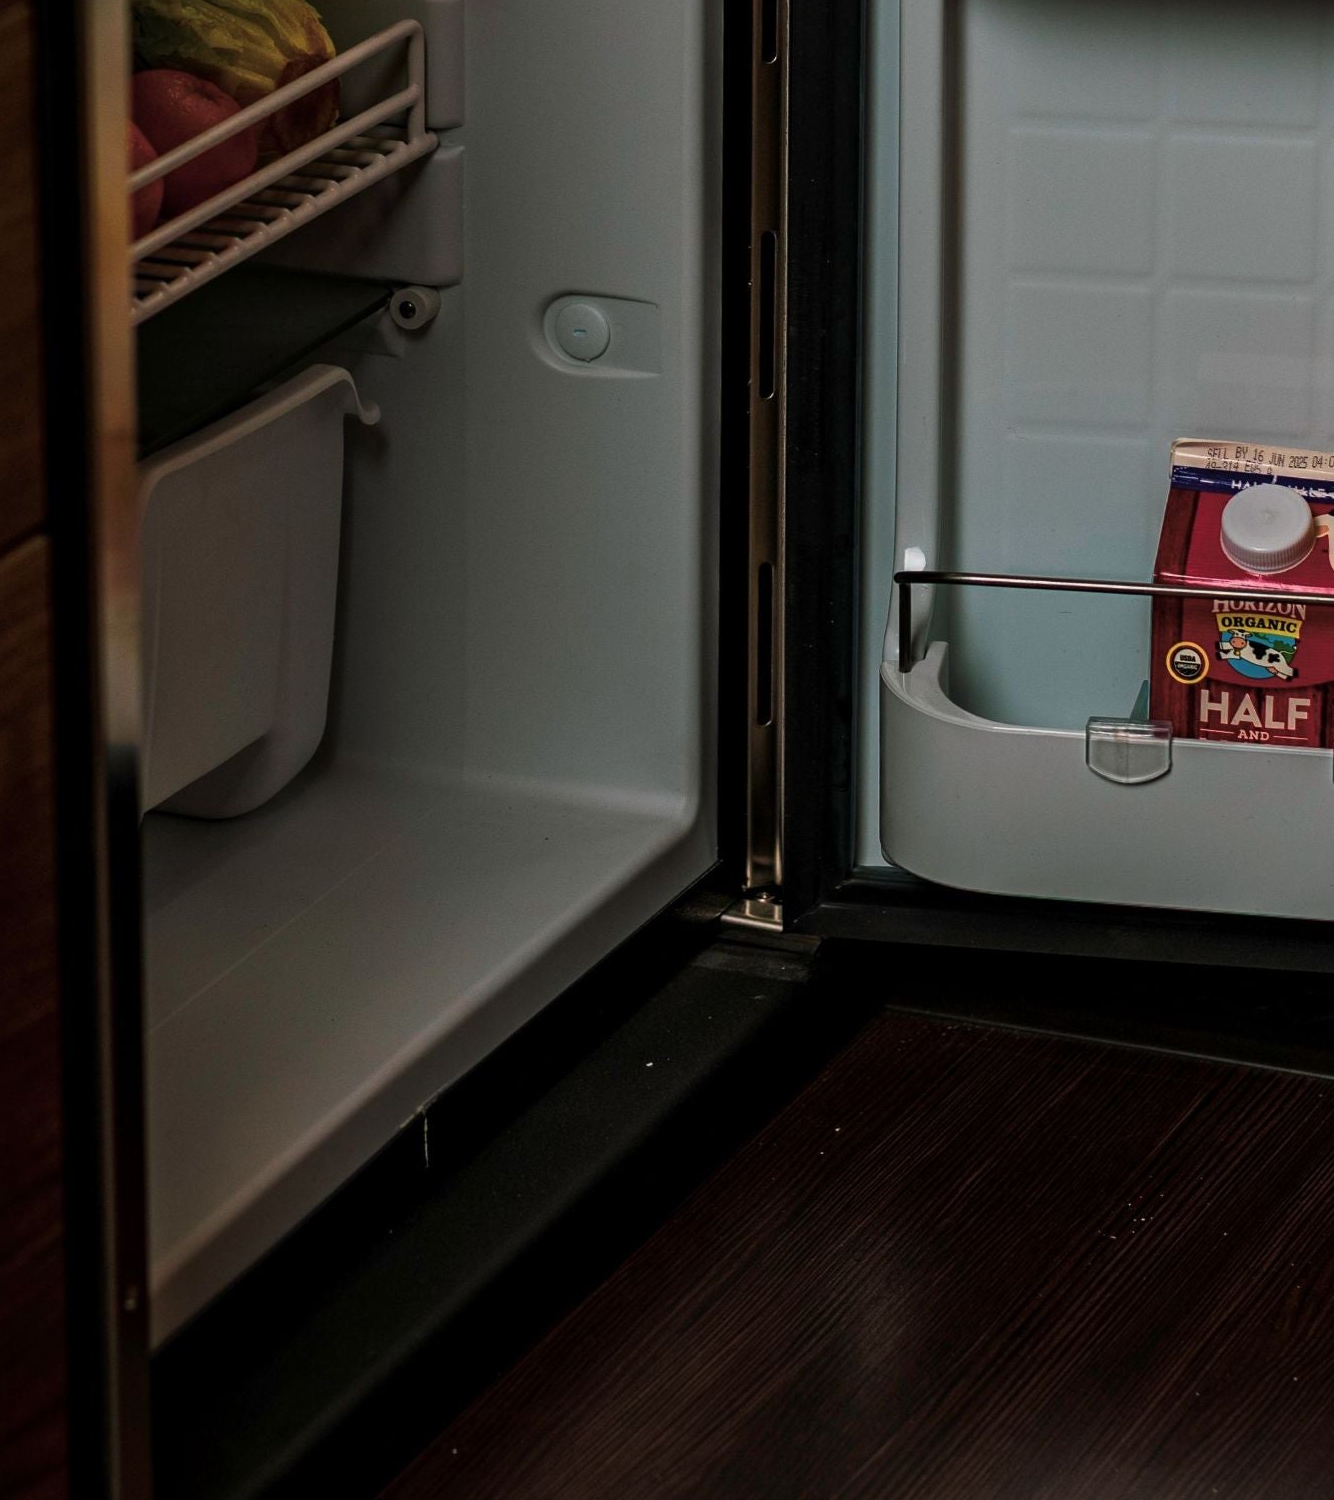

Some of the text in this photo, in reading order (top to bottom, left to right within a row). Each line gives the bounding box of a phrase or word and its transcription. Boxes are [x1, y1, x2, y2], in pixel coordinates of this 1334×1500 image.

[1235, 446, 1248, 459] BY
[1253, 448, 1264, 462] 16
[1269, 452, 1285, 467] JUN
[1288, 455, 1308, 469] 2025
[1211, 599, 1307, 621] HORIZON
[1221, 616, 1297, 634] ORGANIC
[1179, 654, 1196, 662] USDA
[1199, 689, 1311, 731] HALF
[1237, 729, 1270, 741] AND
